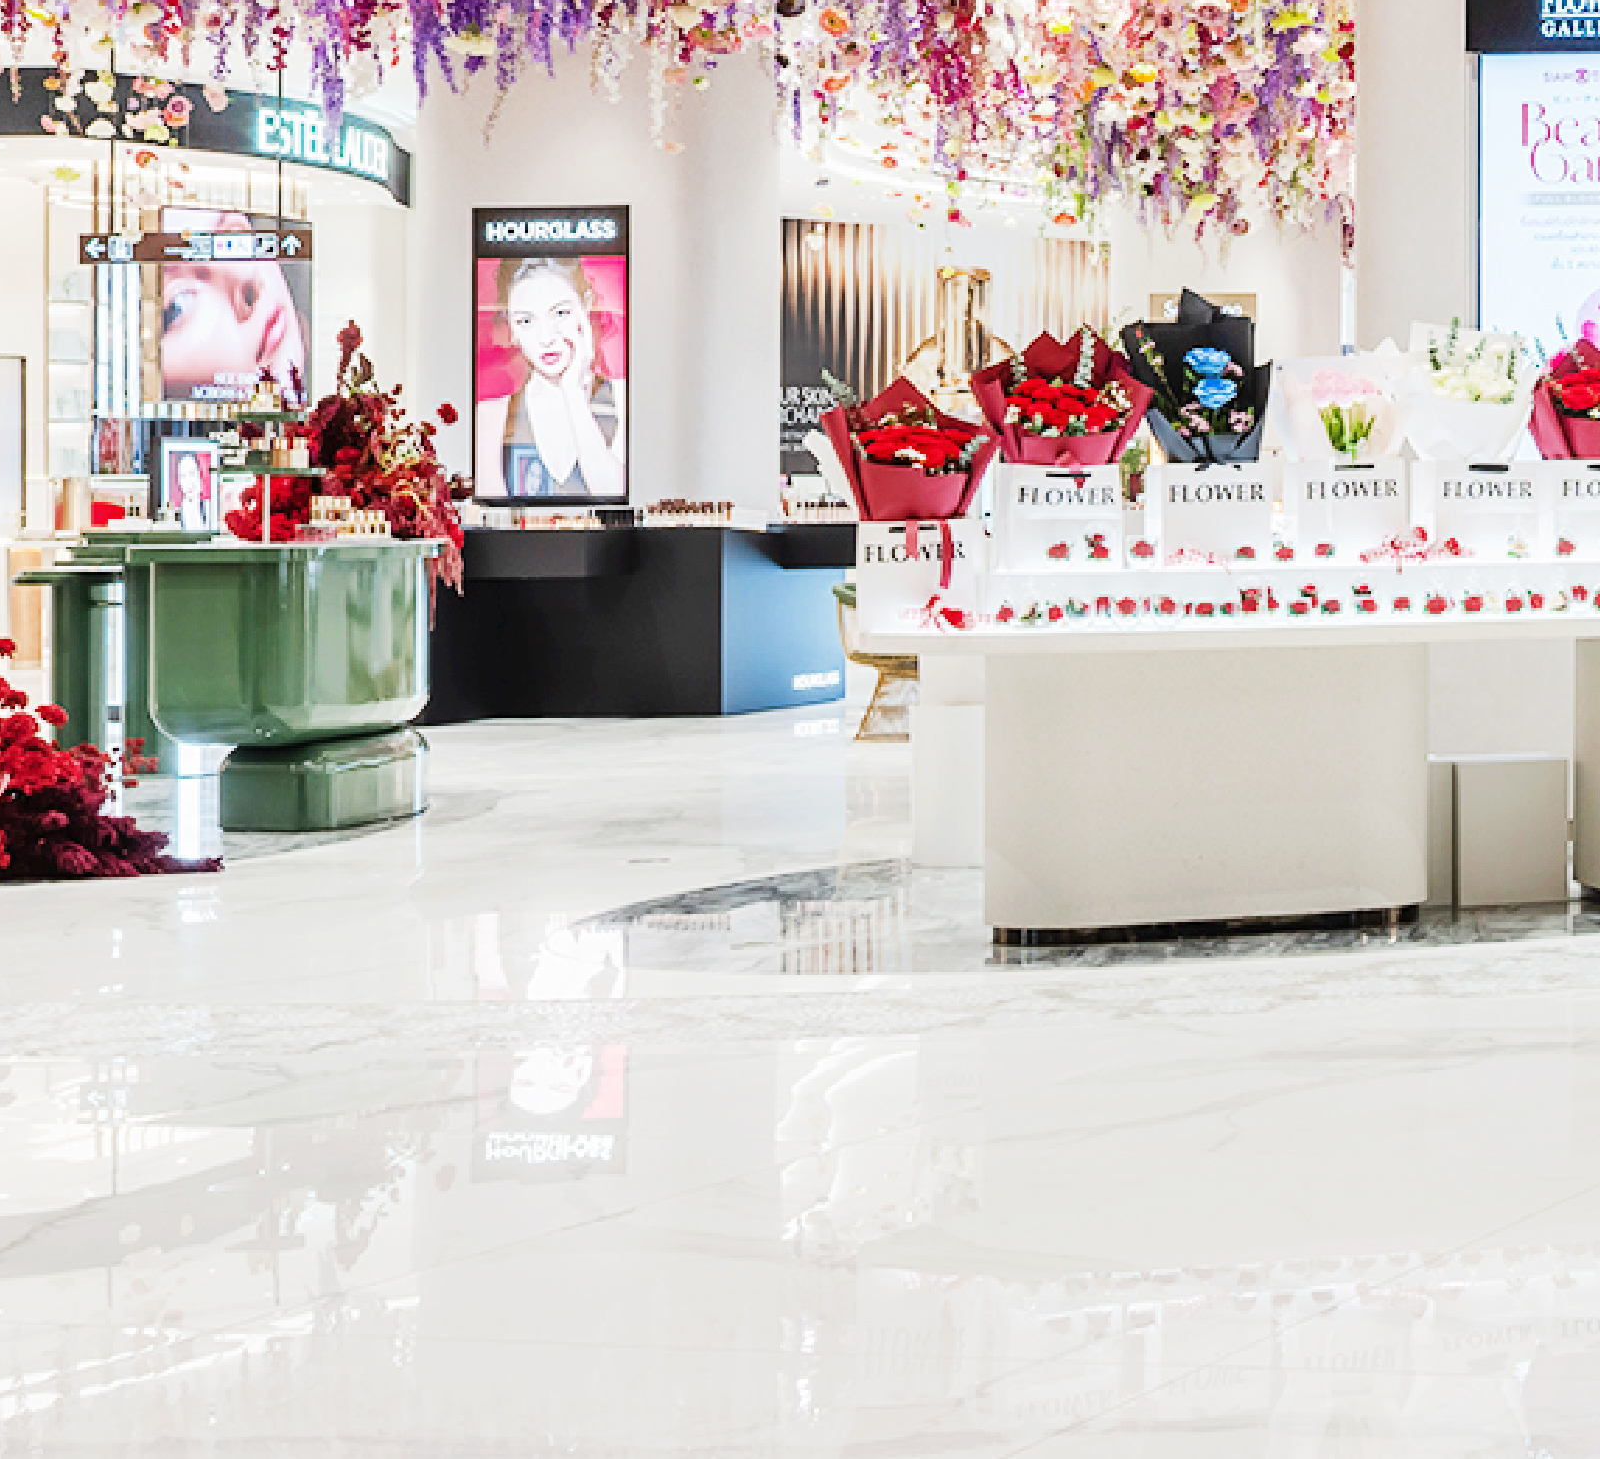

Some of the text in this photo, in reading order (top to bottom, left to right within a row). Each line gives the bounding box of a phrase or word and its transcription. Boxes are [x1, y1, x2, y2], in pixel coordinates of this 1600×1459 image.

[485, 219, 617, 242] HOURGLASS
[1016, 486, 1116, 507] FLOWER
[1168, 482, 1266, 504] FLOWER
[1306, 478, 1400, 501] FLOWER
[1442, 479, 1534, 499] FLOWER
